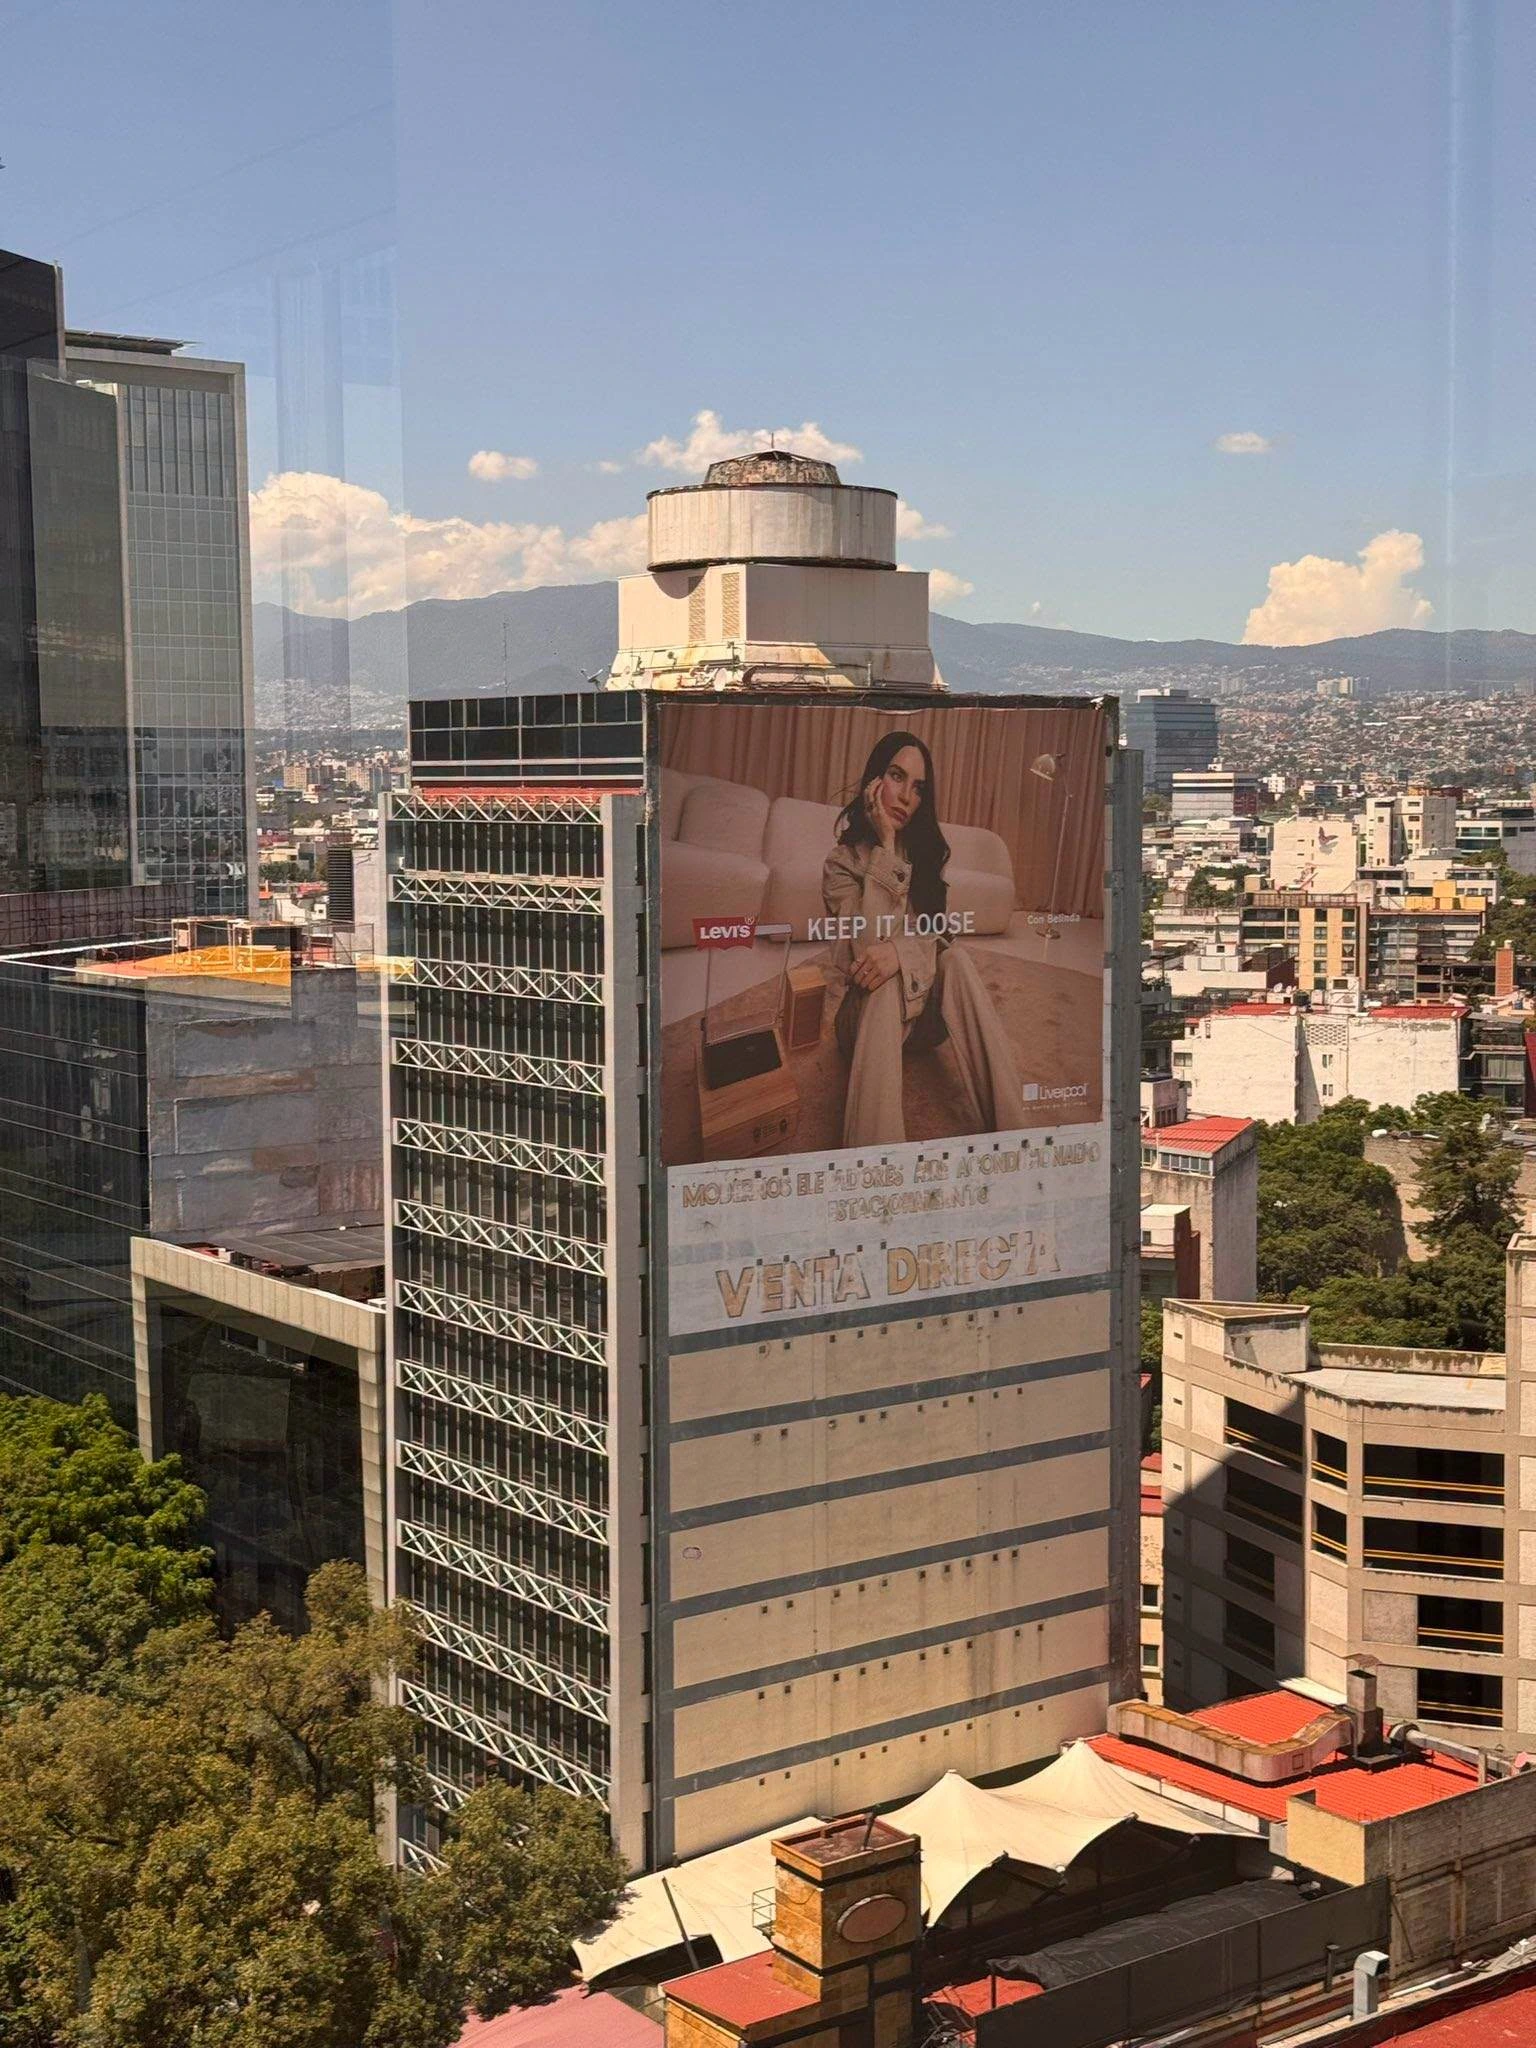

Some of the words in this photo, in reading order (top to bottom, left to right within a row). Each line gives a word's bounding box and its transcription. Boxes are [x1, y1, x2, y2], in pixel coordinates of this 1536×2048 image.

[807, 915, 868, 941] KEEP
[876, 914, 896, 938] IT
[904, 911, 976, 937] LOOSE
[1027, 915, 1045, 924] Con
[1040, 1083, 1088, 1101] Liverpool
[715, 1252, 871, 1318] VENTA
[886, 1230, 1061, 1296] DIRECTA
